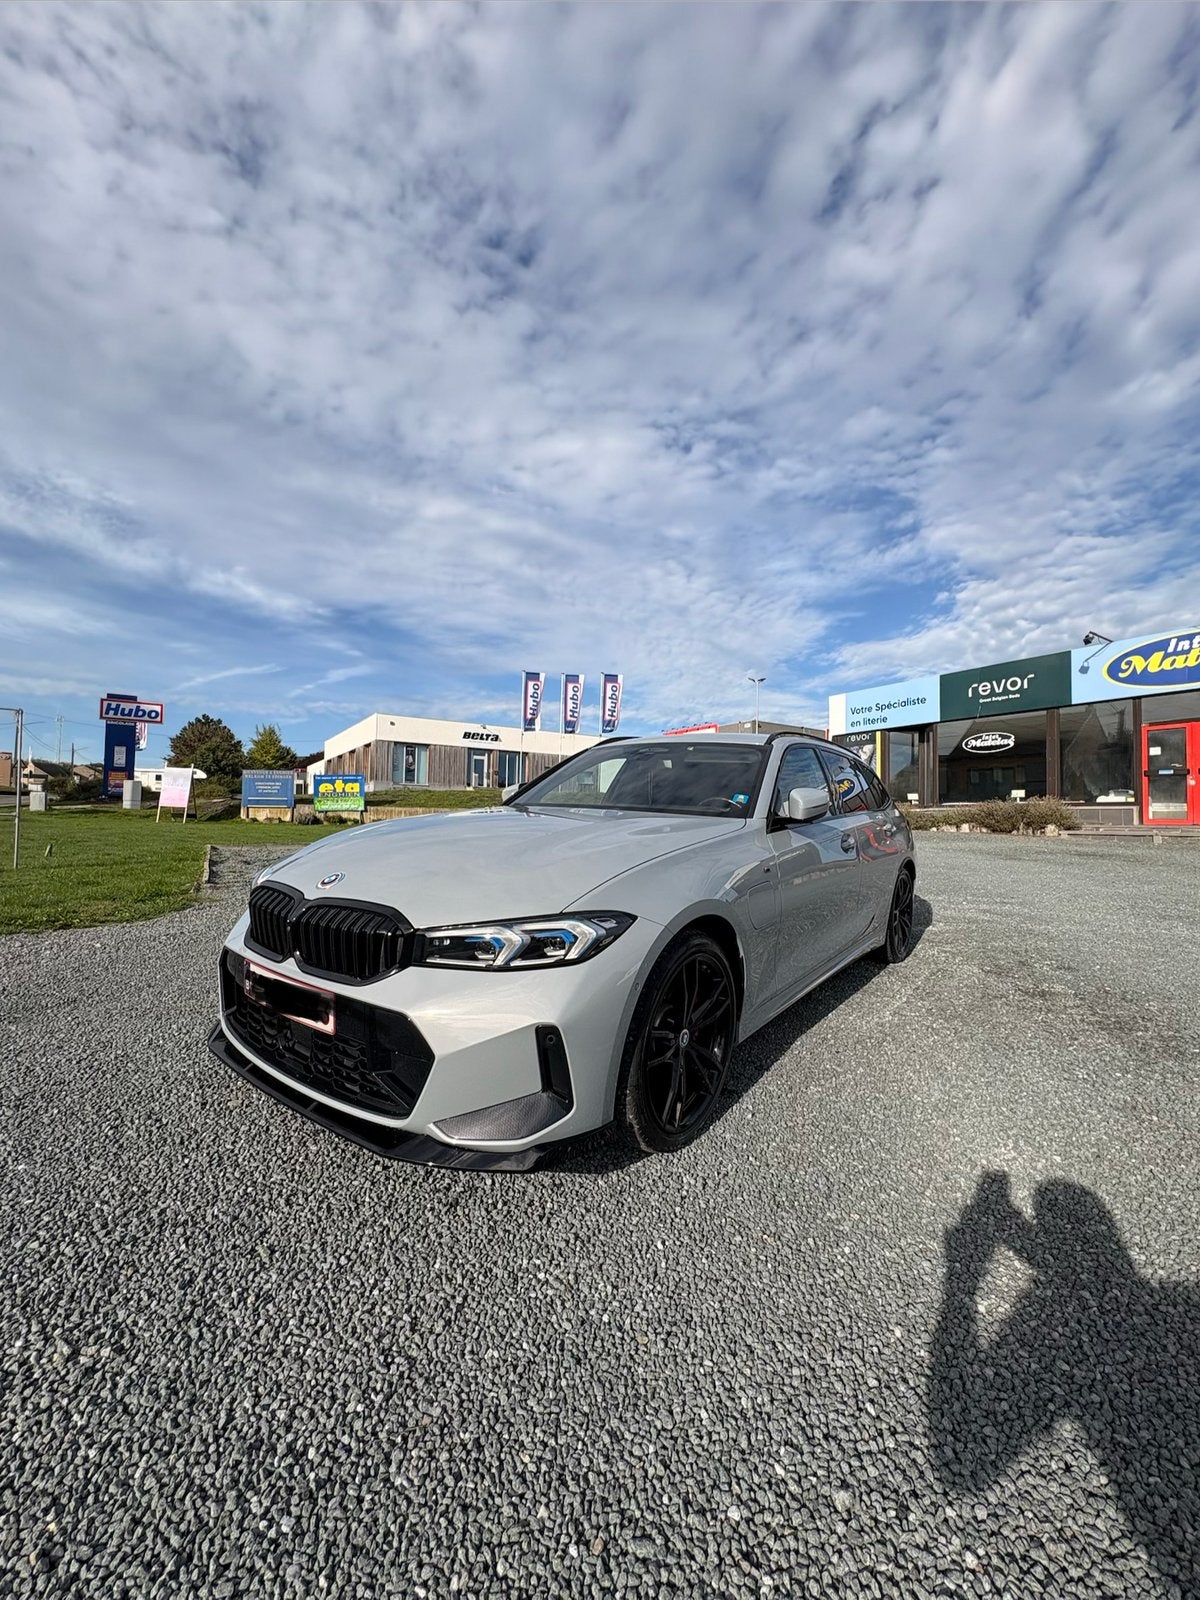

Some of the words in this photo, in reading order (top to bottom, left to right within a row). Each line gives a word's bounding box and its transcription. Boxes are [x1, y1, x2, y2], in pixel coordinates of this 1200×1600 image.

[1167, 635, 1200, 653] Int
[1119, 648, 1200, 678] Mat
[968, 674, 1035, 698] revor
[529, 683, 540, 717] Hubo
[569, 685, 580, 719] Hubo
[607, 684, 618, 718] Hubo
[850, 706, 873, 715] Votre
[875, 697, 927, 712] Spécialiste
[104, 702, 160, 719] Hubo
[850, 720, 861, 728] en
[863, 715, 888, 726] literie
[846, 733, 872, 742] revor
[319, 780, 360, 793] eta
